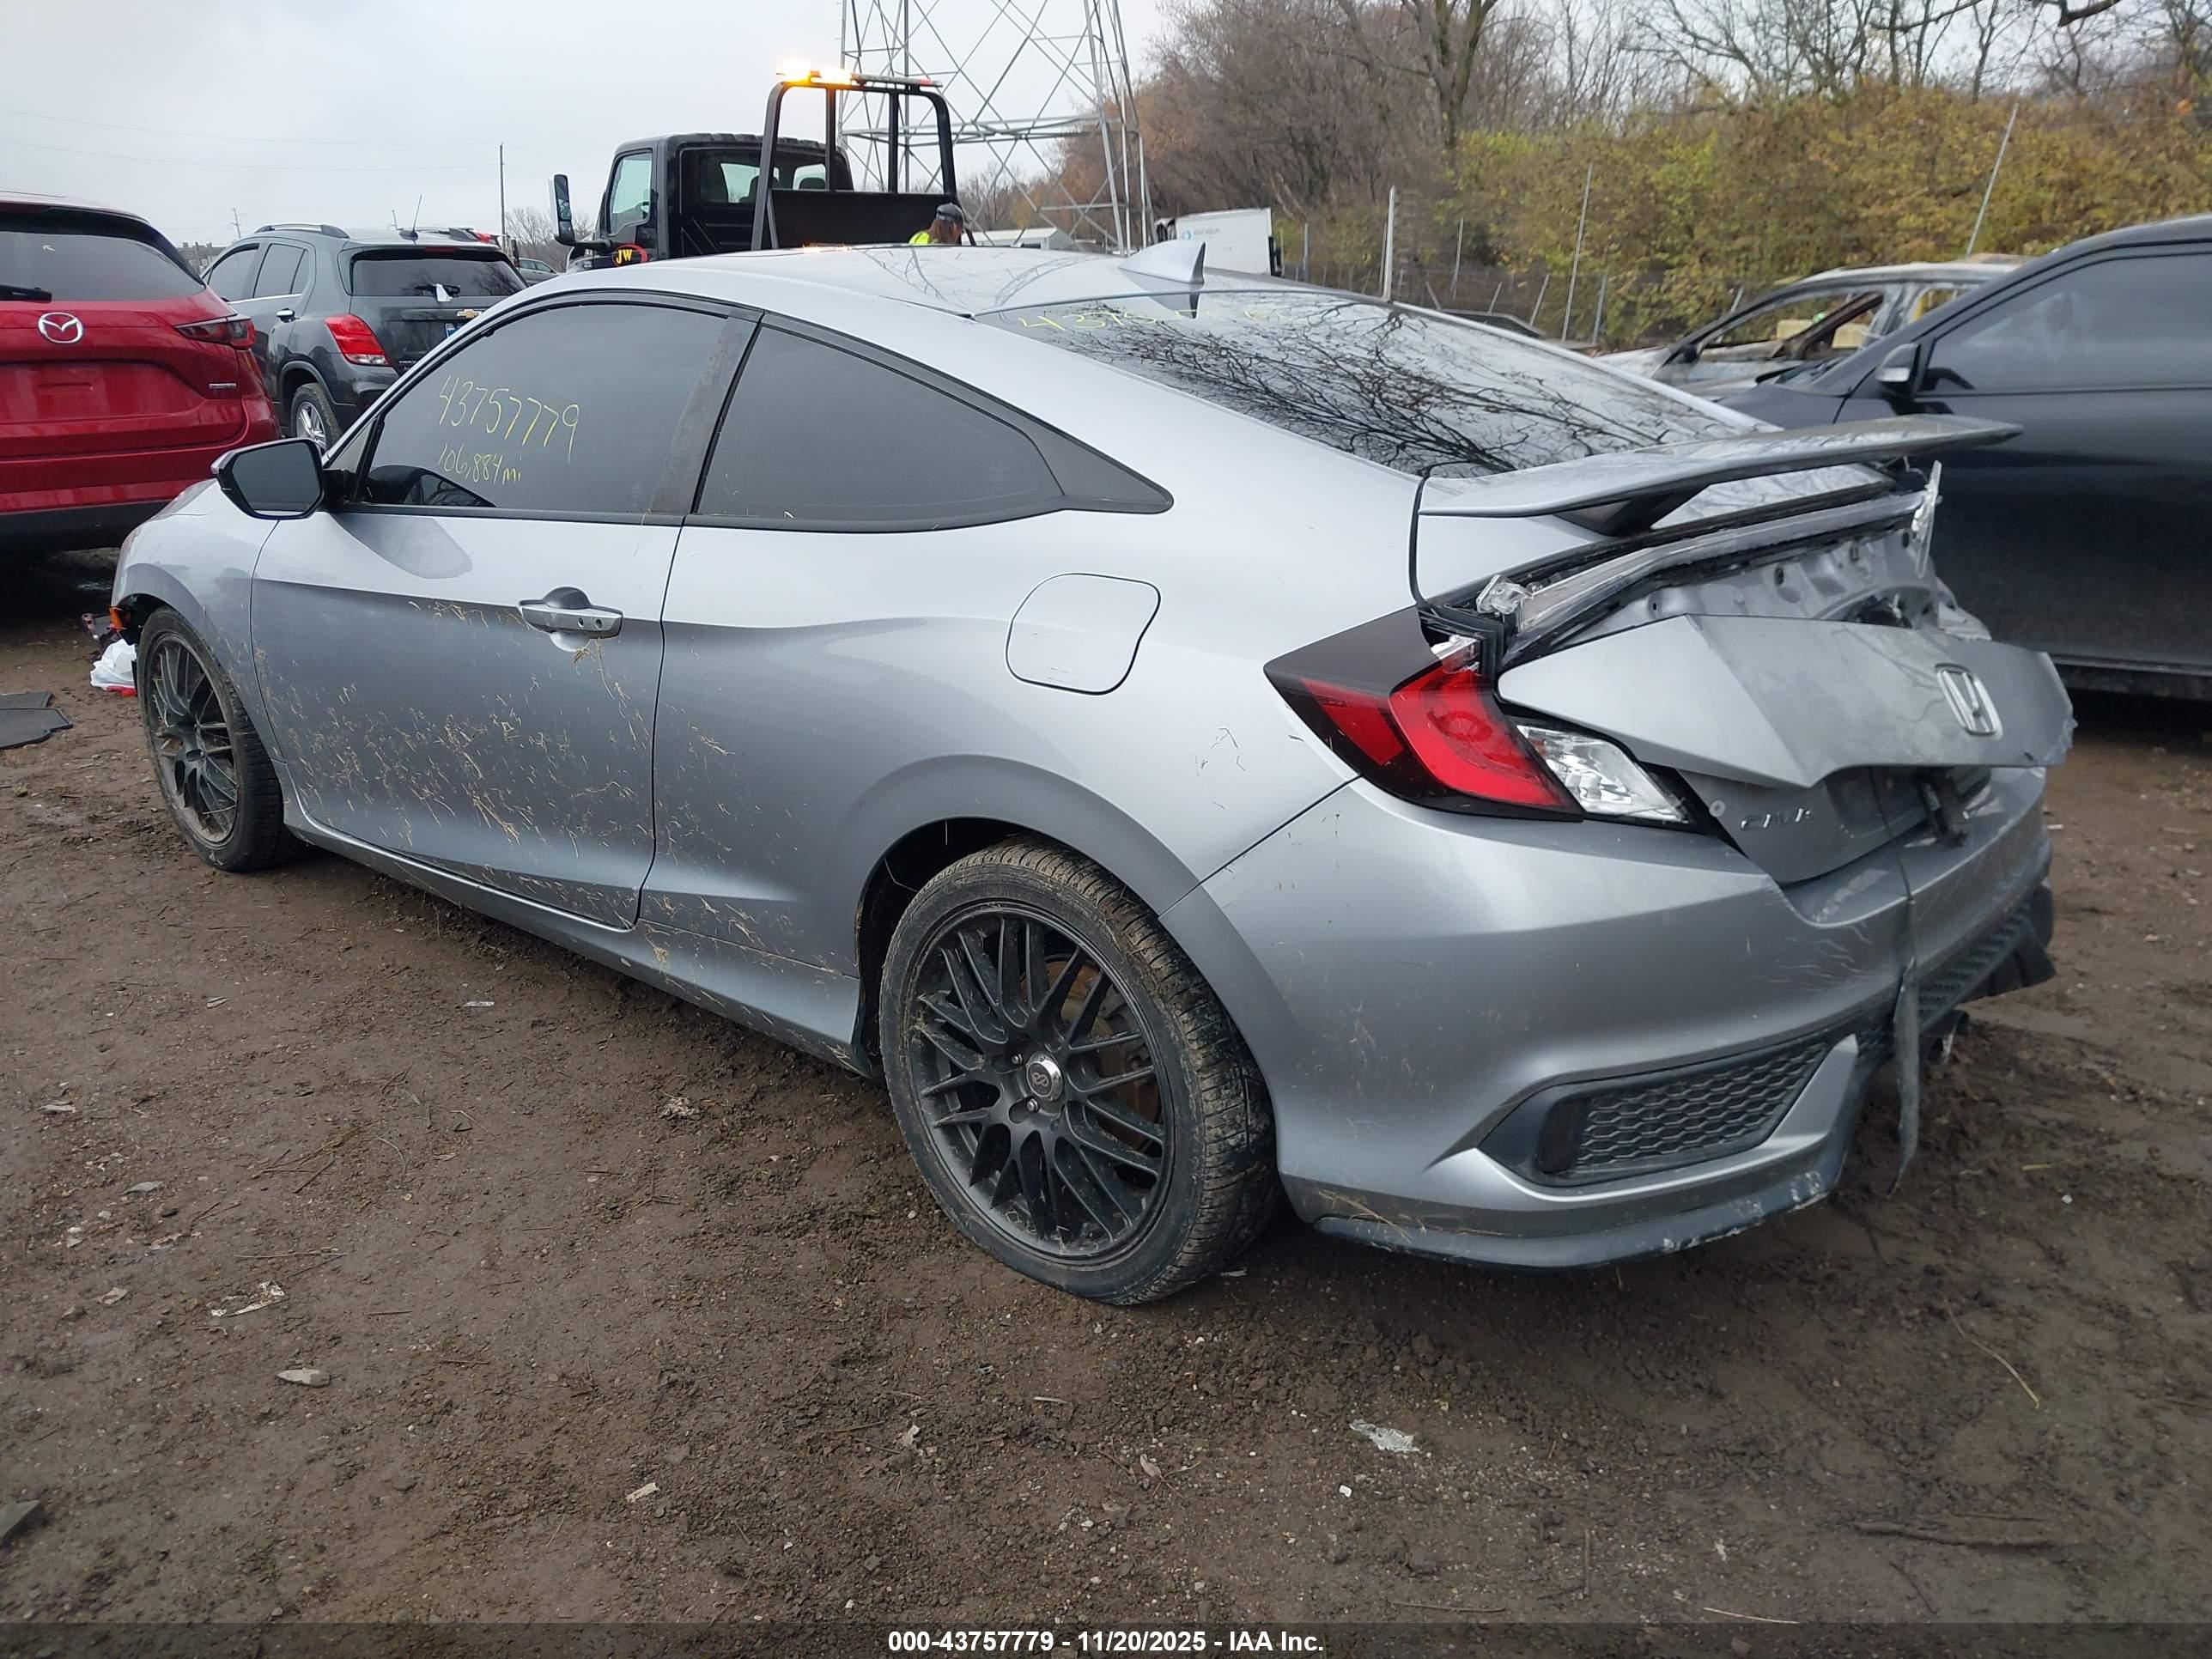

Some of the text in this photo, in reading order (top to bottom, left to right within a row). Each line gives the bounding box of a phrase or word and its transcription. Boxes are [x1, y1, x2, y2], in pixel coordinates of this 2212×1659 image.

[616, 248, 633, 264] JW
[439, 375, 580, 465] 43757779
[438, 442, 503, 485] 106,884
